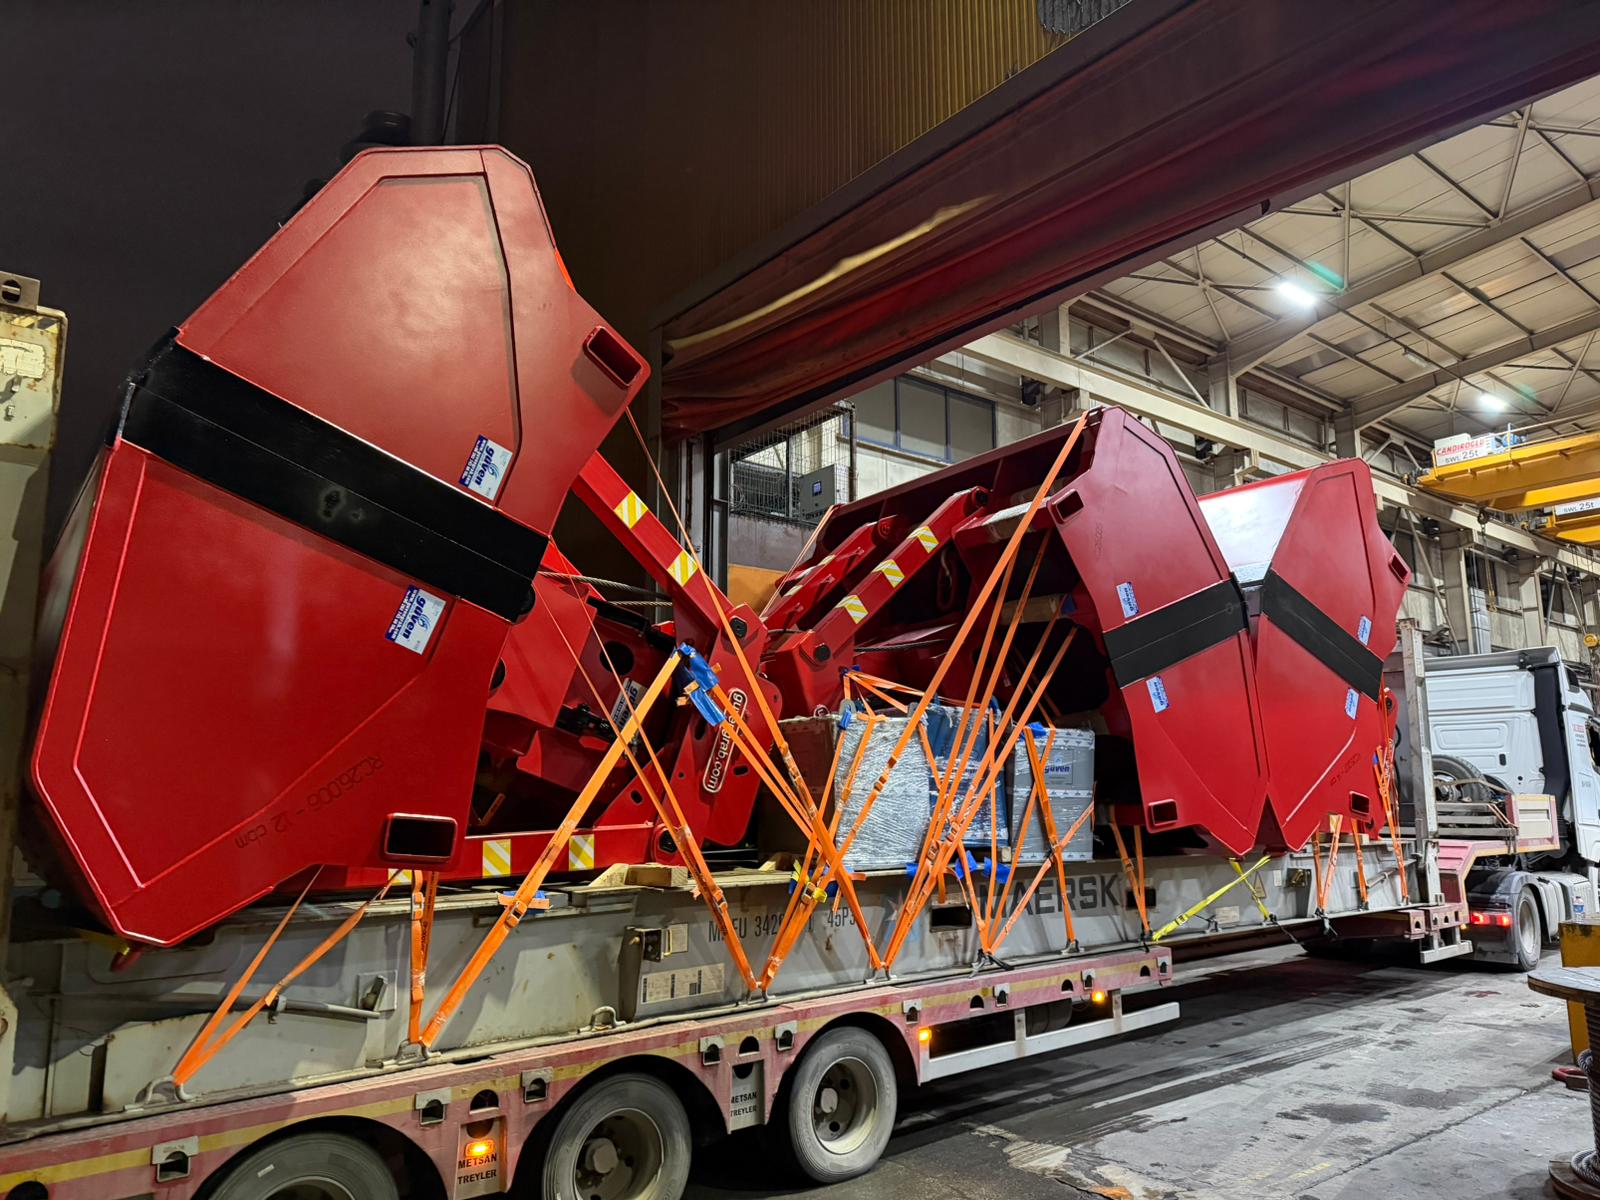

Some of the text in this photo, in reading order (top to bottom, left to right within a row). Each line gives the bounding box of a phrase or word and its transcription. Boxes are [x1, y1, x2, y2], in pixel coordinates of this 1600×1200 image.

[1462, 450, 1479, 459] 25t
[1579, 501, 1594, 510] 25t
[707, 692, 744, 789] guengrab.com
[980, 874, 1121, 919] MAERSK
[457, 1153, 497, 1169] METSAN
[457, 1169, 497, 1185] TREYLER
